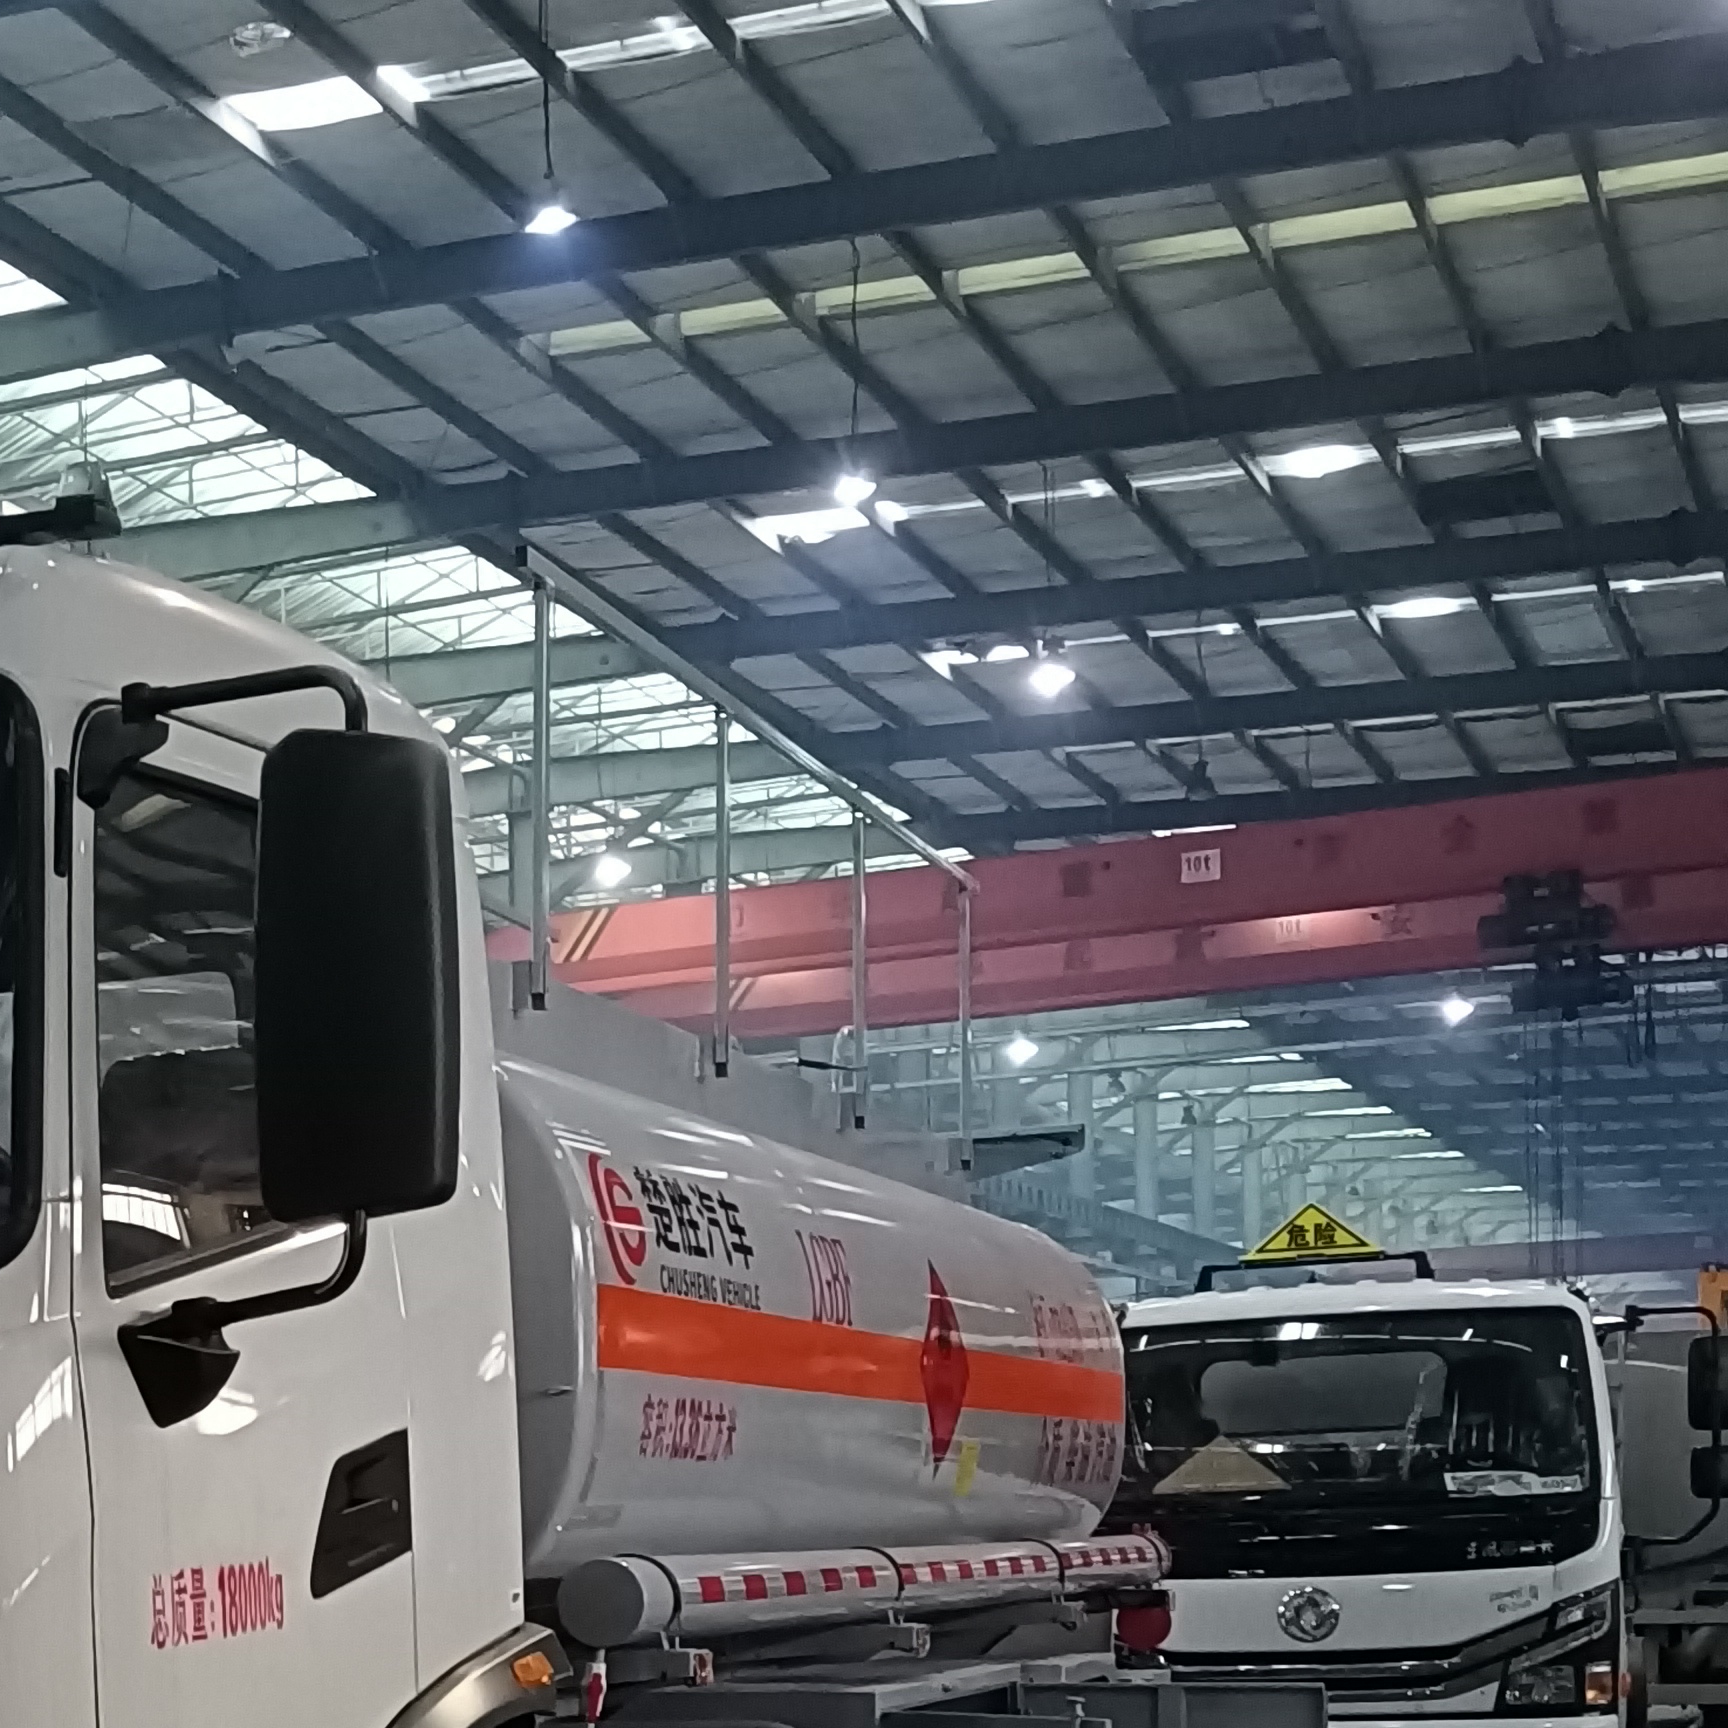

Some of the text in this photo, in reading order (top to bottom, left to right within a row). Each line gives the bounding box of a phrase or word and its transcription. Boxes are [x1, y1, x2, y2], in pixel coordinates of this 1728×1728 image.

[1185, 854, 1211, 872] 10t
[633, 1165, 754, 1270] 楚胜汽车
[1286, 1221, 1338, 1247] 危险
[660, 1264, 761, 1311] CHUSHENG VEHICLE
